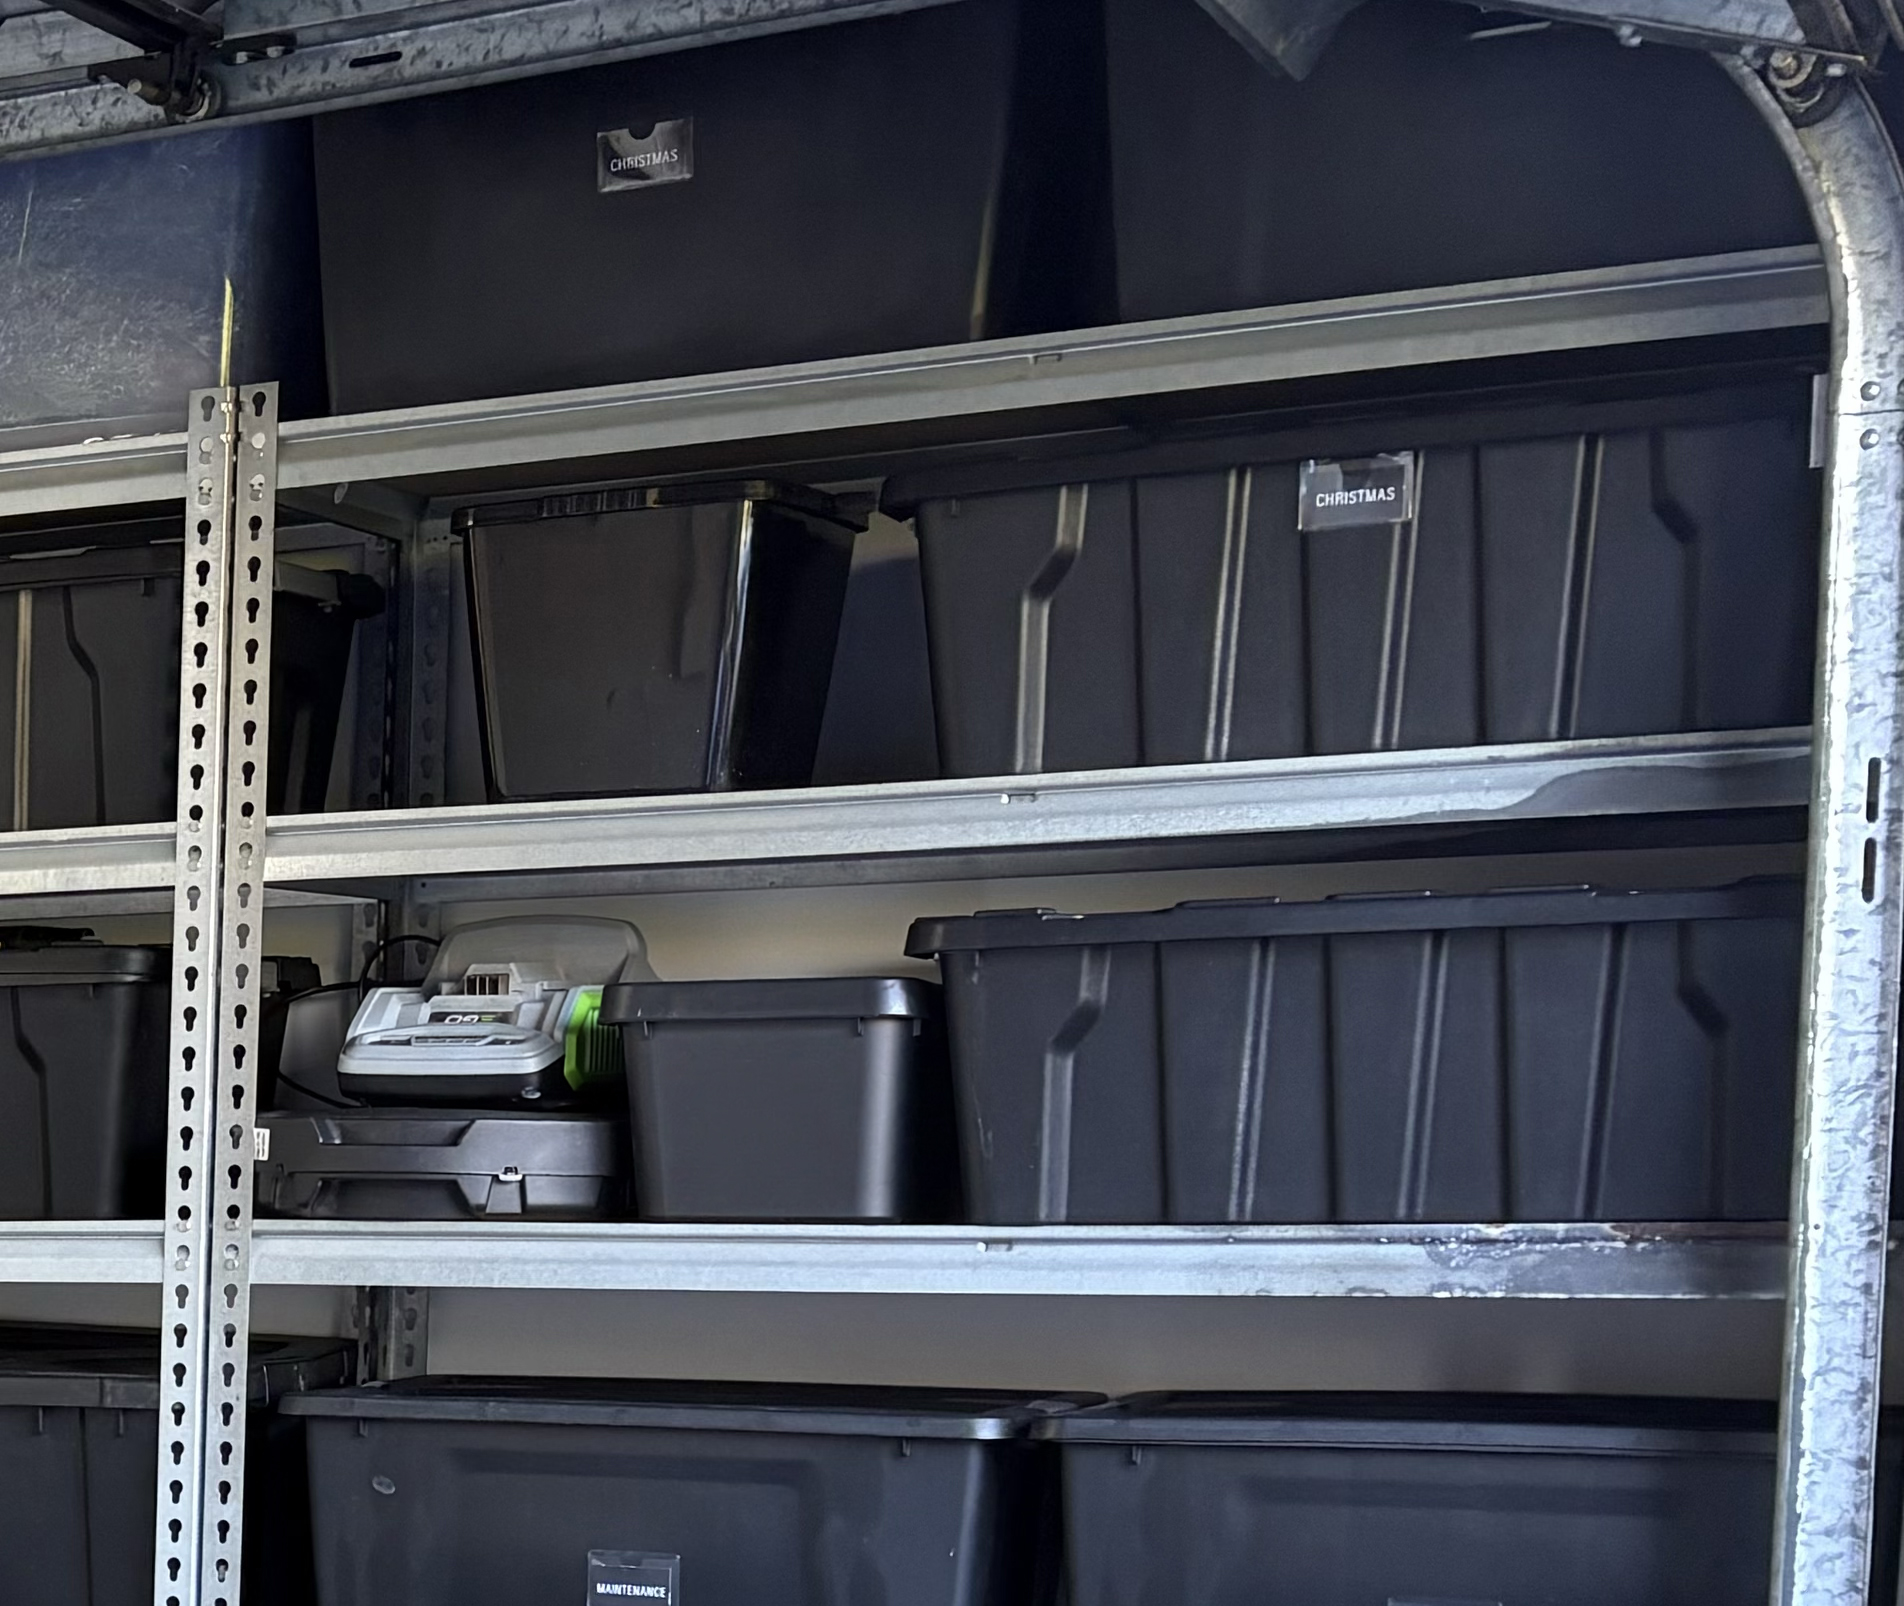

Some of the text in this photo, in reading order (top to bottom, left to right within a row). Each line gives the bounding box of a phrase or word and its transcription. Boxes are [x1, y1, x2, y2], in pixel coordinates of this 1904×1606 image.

[611, 149, 678, 172] CHRISTMAS
[1316, 487, 1395, 507] CHRISTMAS
[597, 1583, 666, 1598] MAINTENANCE
